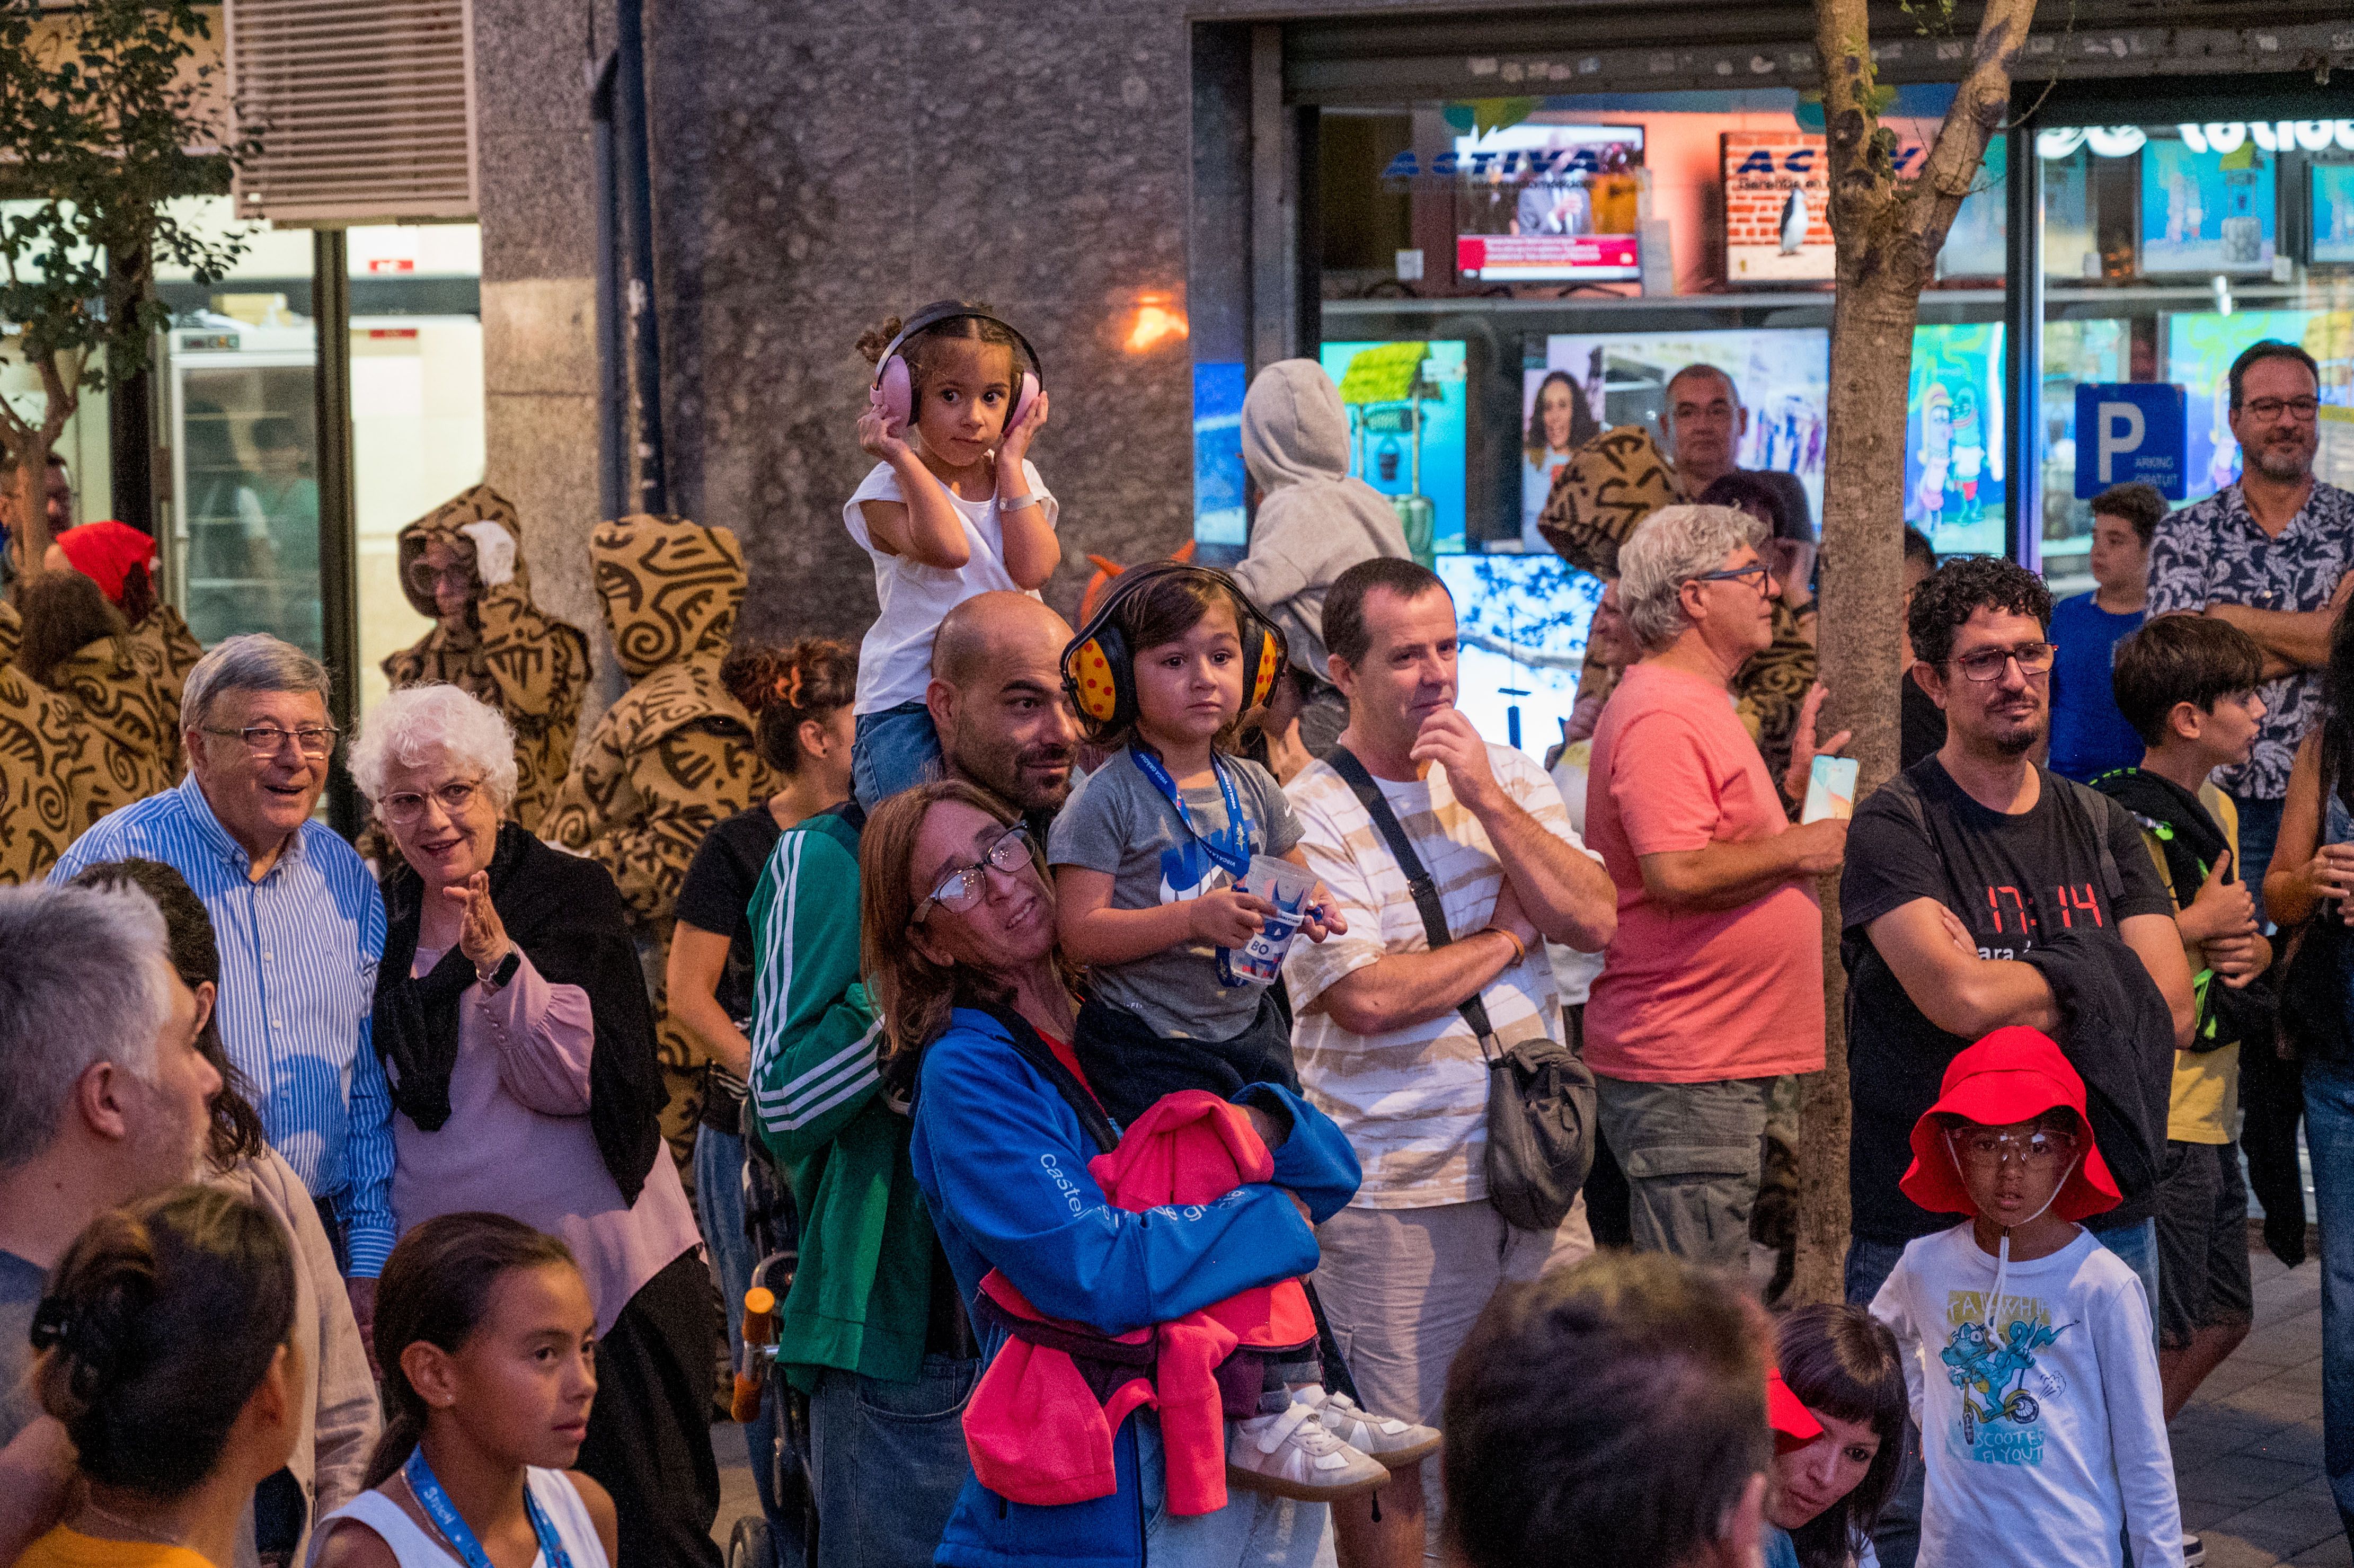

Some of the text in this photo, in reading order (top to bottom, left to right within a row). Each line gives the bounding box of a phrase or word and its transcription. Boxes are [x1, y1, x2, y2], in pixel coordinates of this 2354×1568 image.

[2098, 401, 2146, 484] P
[1155, 770, 1168, 785] VISCA
[1218, 855, 1236, 868] VISCA
[1251, 940, 1269, 955] BO
